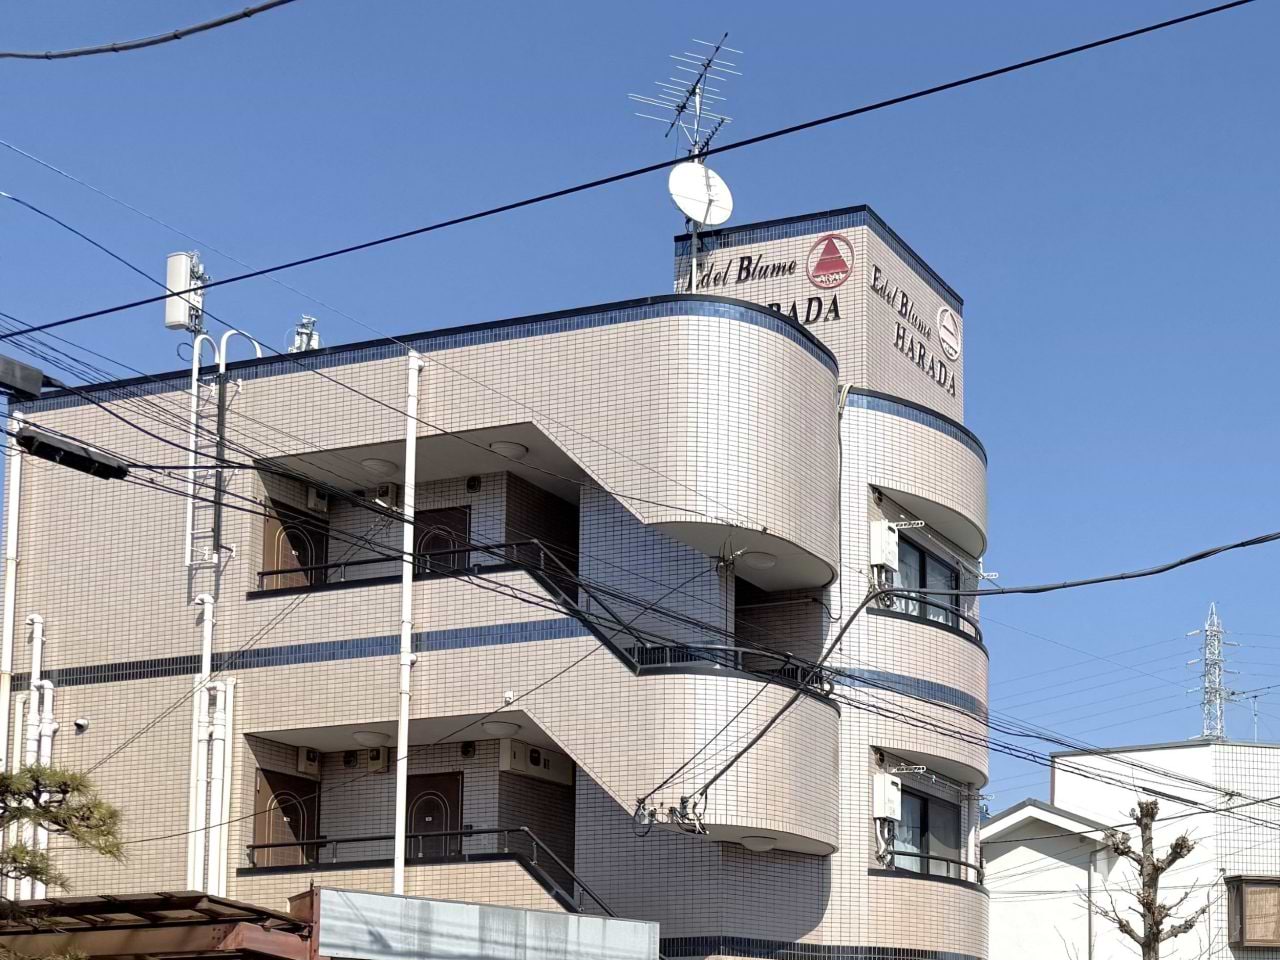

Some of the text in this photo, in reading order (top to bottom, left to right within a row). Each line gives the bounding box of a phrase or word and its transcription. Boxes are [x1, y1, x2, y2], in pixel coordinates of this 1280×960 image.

[735, 253, 797, 284] Blume
[898, 290, 932, 341] Blume
[893, 321, 956, 397] HARADA
